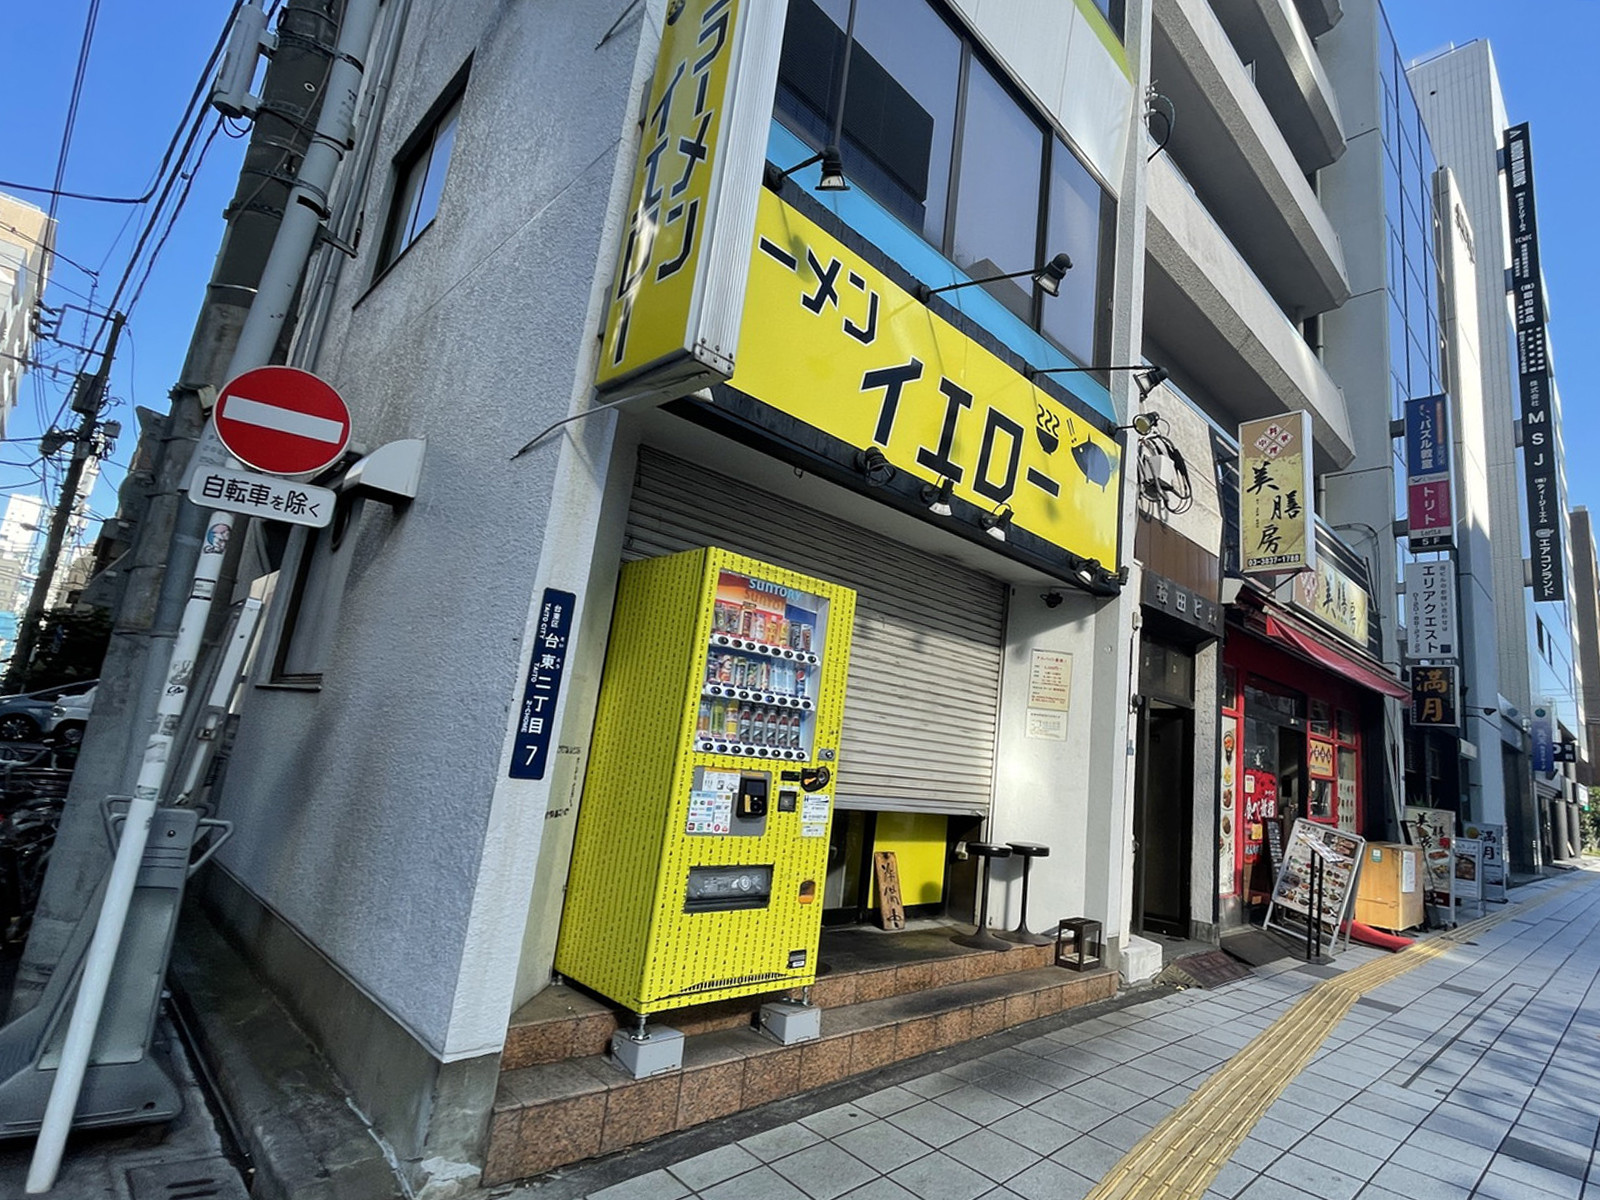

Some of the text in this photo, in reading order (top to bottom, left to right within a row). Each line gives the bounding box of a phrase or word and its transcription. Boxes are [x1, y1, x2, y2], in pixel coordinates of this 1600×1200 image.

[614, 58, 687, 367] イエロー
[859, 356, 1061, 500] イエロー
[202, 474, 321, 518] 自転車を除く
[1422, 565, 1438, 654] エリアクエスト
[528, 632, 560, 734] 台東二丁目
[1416, 669, 1448, 722] 満月
[525, 745, 538, 766] 7
